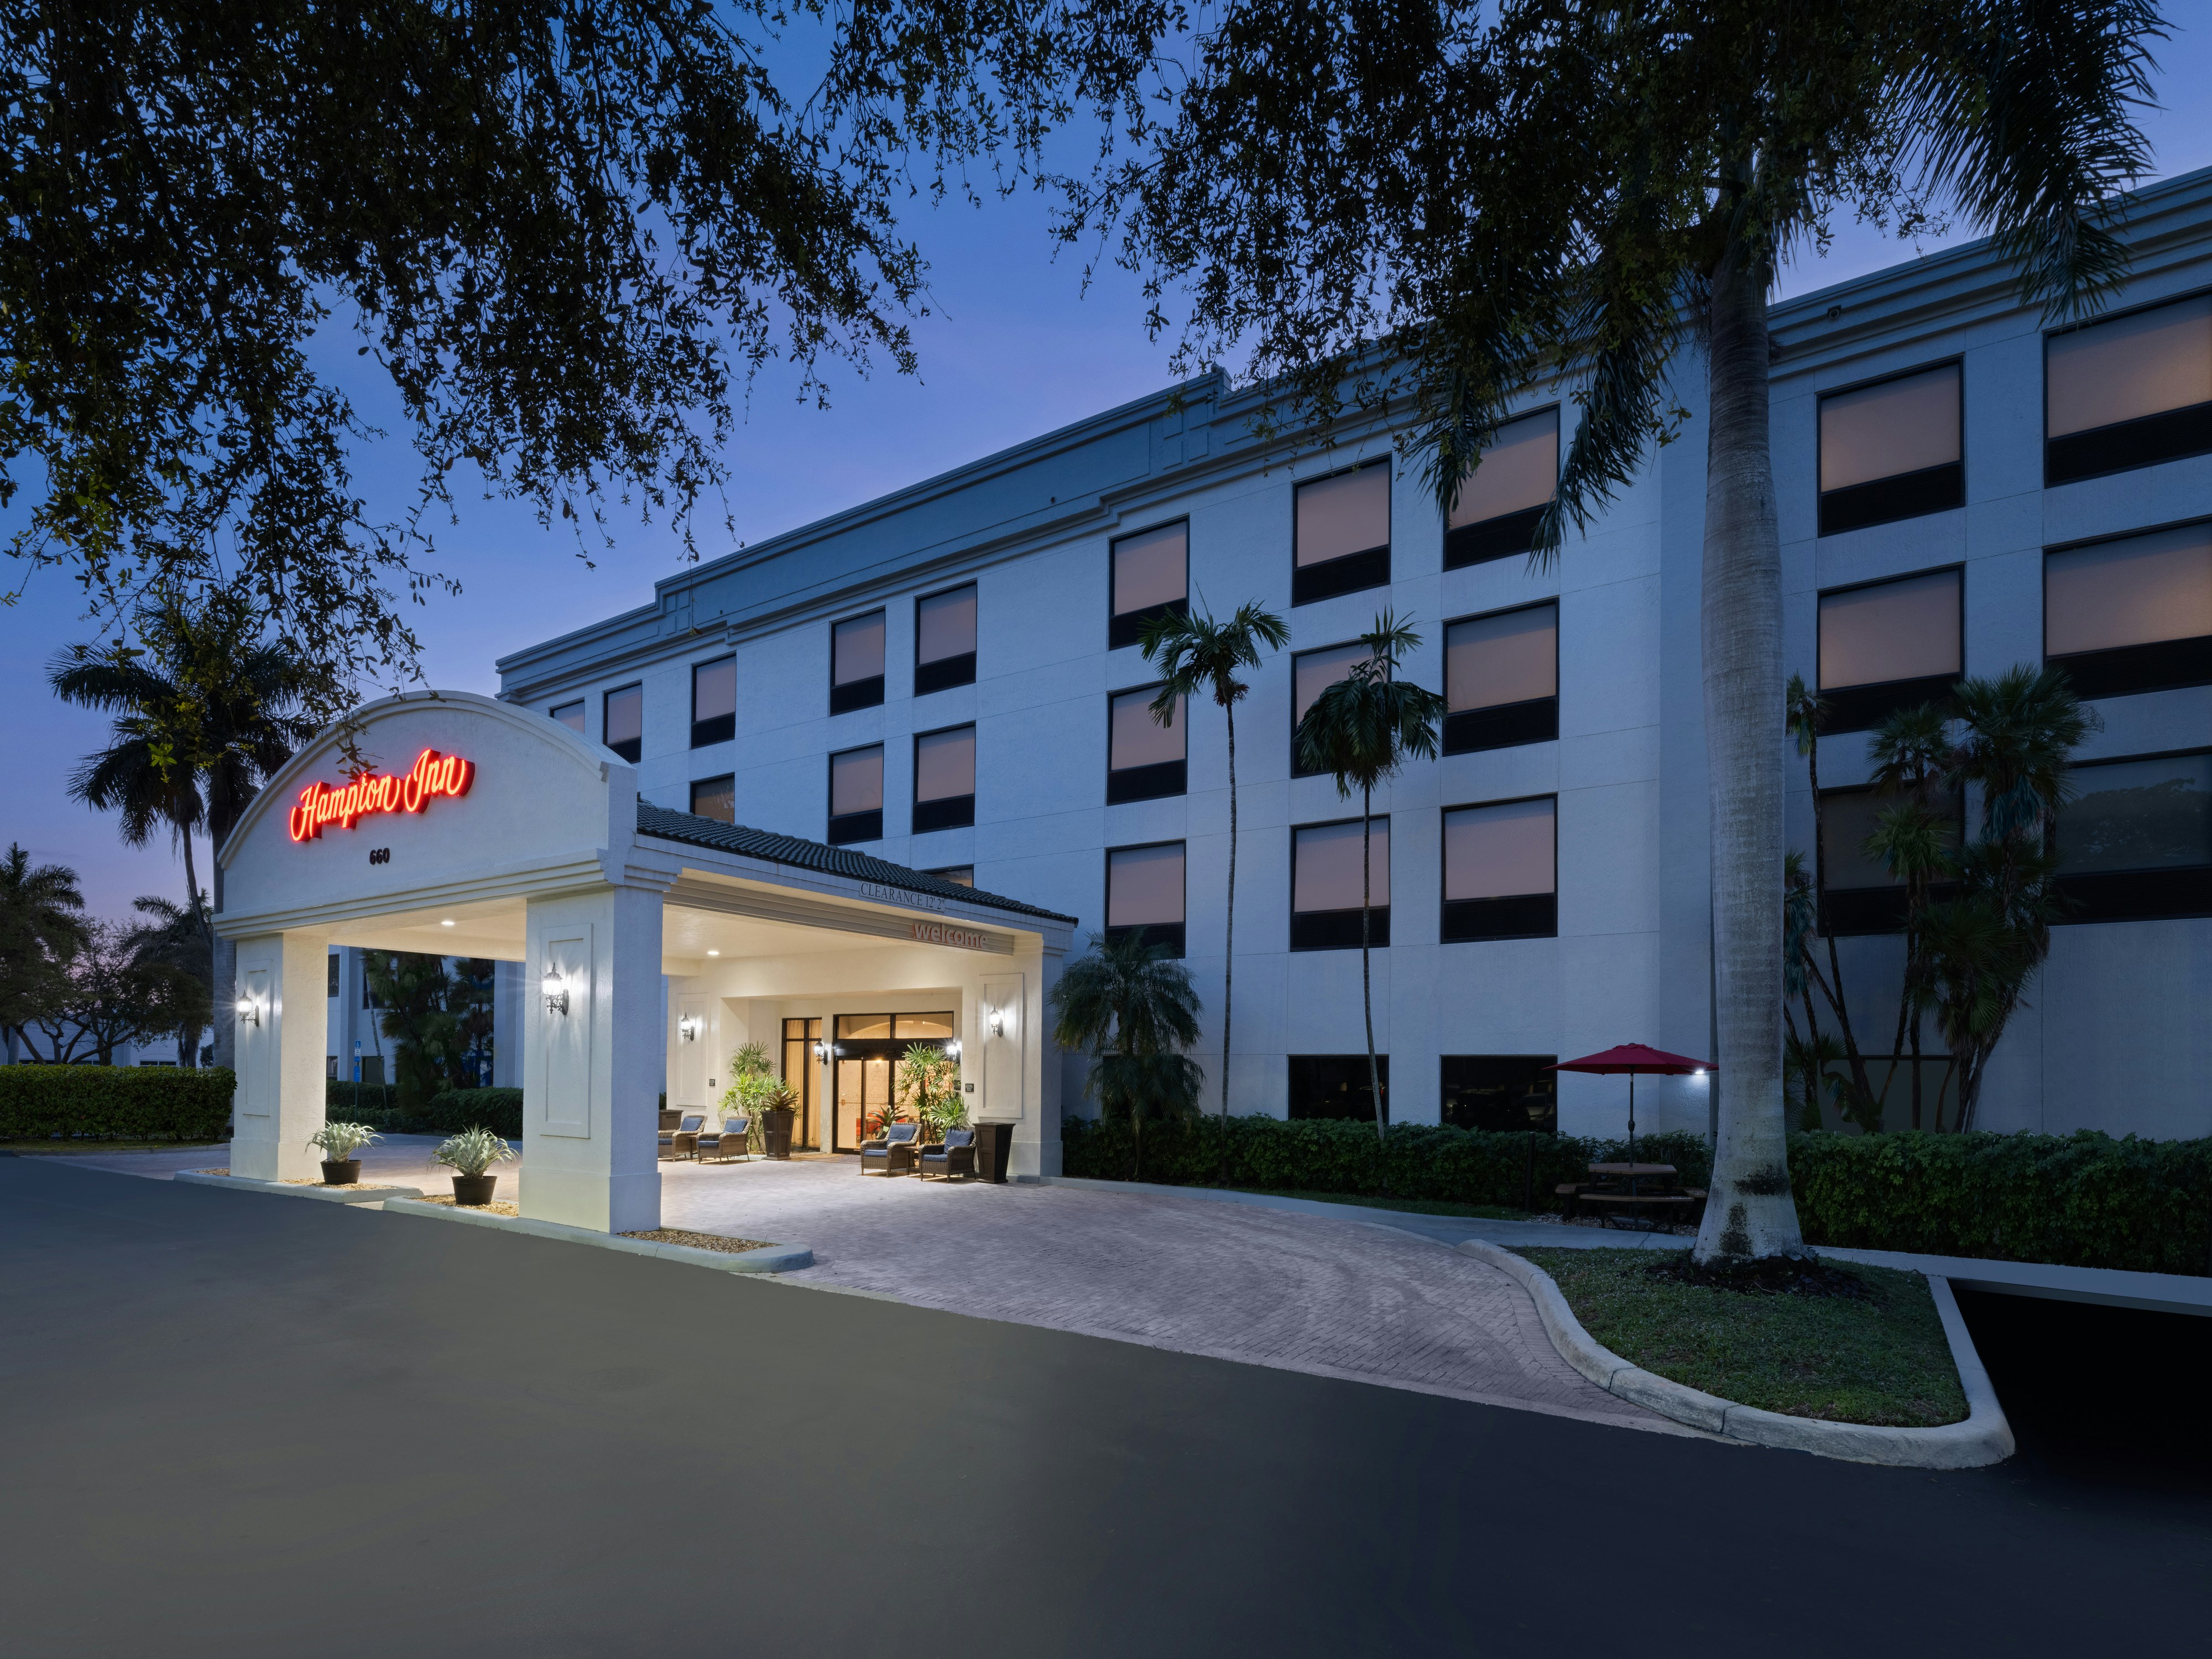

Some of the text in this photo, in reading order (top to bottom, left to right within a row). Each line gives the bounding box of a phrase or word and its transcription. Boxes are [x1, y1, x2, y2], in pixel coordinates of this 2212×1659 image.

[290, 749, 470, 842] Hampton Inn
[369, 848, 390, 865] 660
[861, 883, 922, 906] CLEARANCE
[926, 896, 935, 908] 12'
[914, 924, 988, 948] welcome
